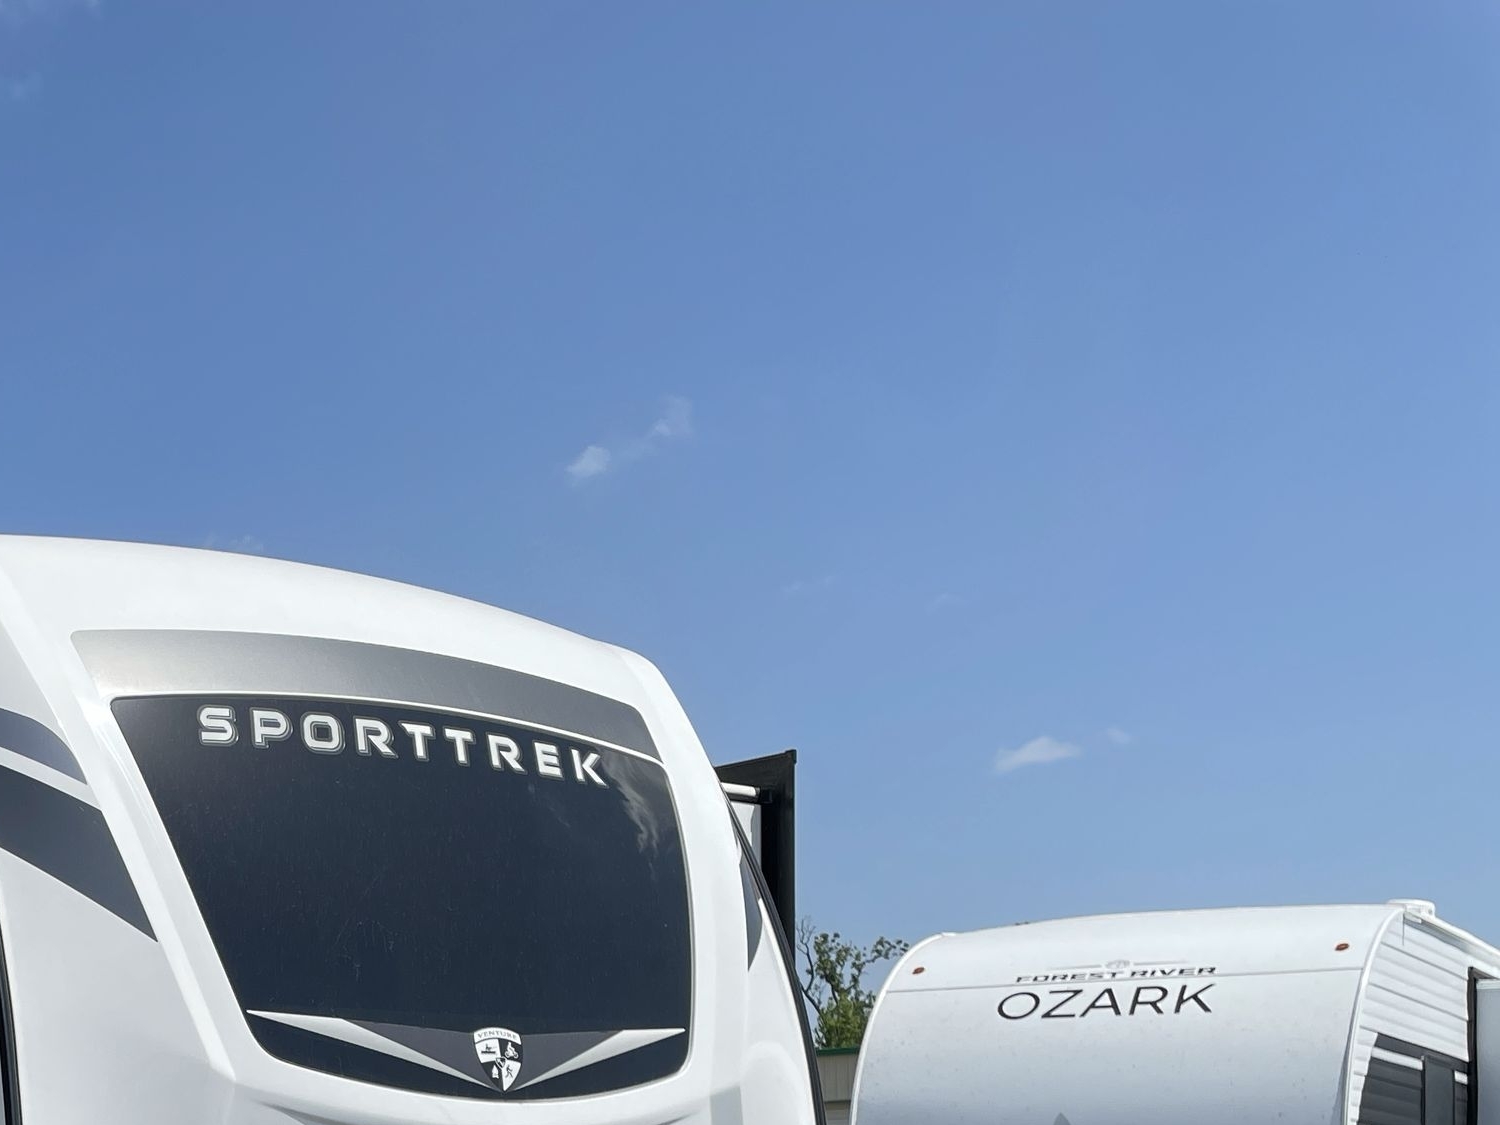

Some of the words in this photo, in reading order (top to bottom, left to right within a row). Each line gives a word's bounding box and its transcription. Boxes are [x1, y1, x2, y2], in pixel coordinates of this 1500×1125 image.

[196, 704, 609, 790] SPORTTREK
[1015, 970, 1125, 984] FOREST
[1129, 966, 1218, 978] RIVER
[996, 982, 1217, 1021] OZARK
[477, 1029, 518, 1040] VENTURE
